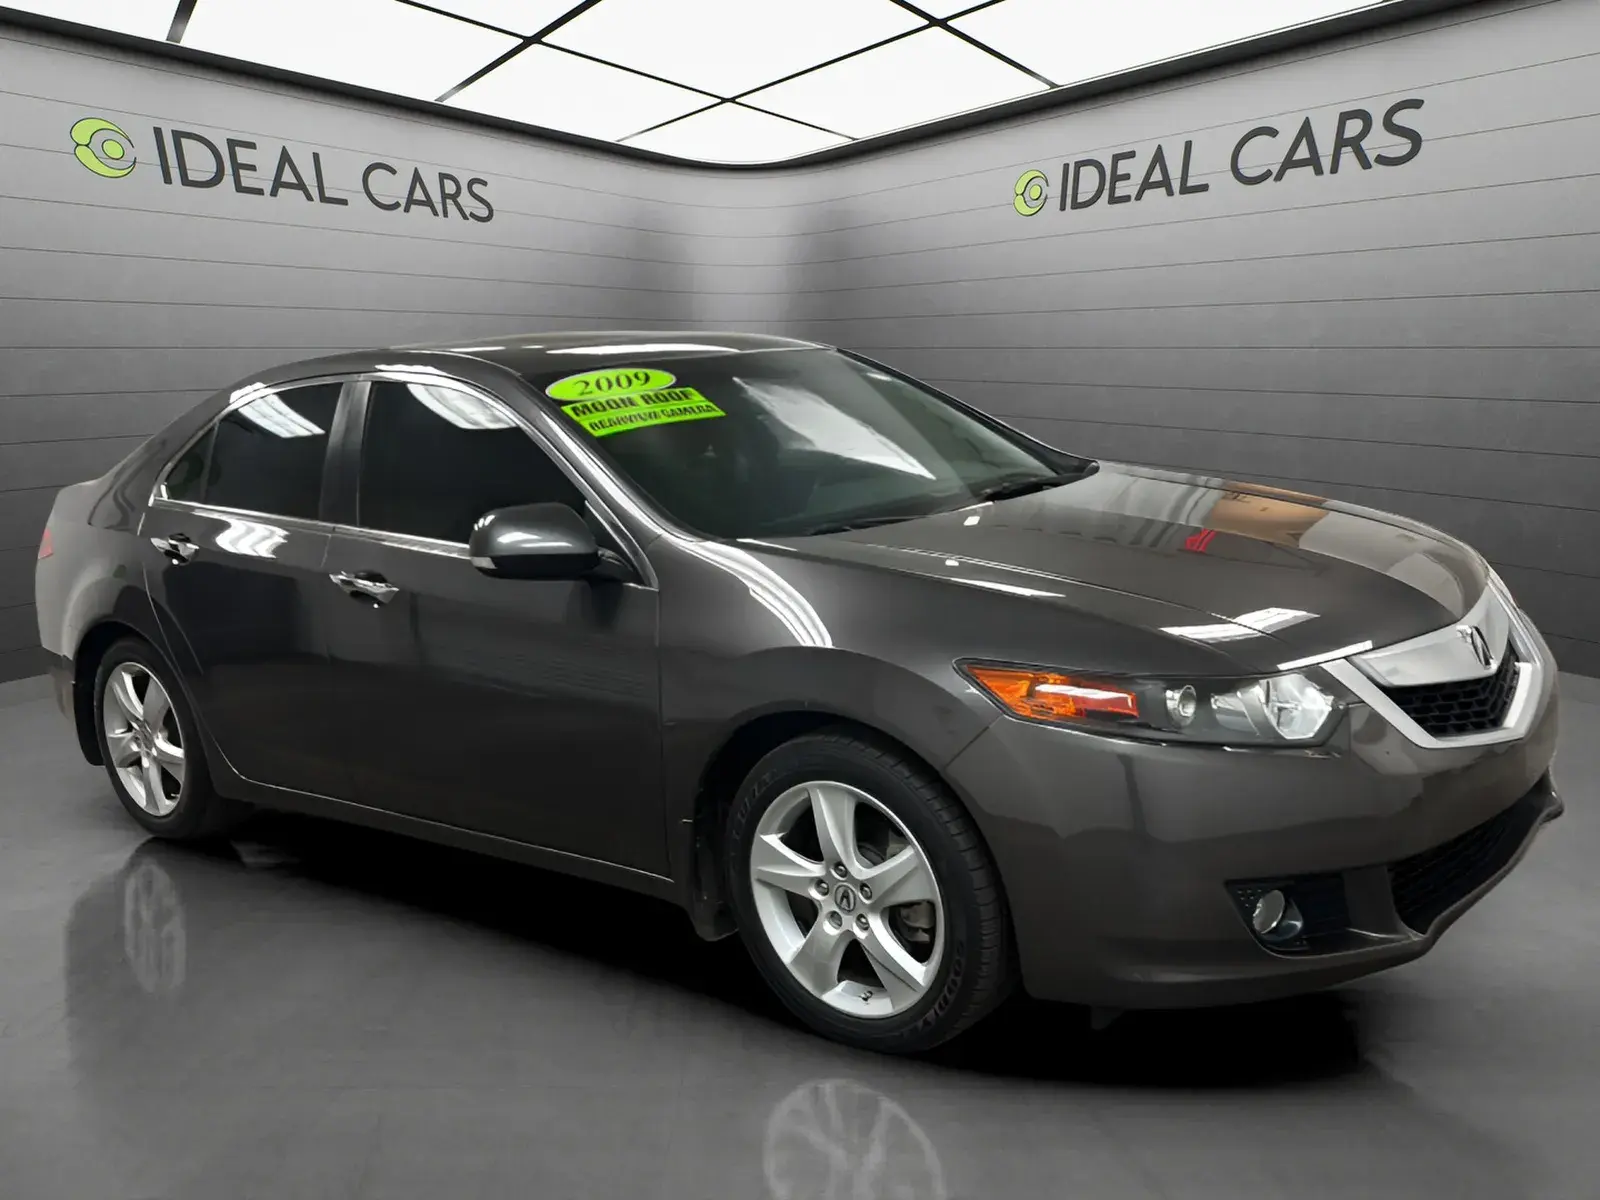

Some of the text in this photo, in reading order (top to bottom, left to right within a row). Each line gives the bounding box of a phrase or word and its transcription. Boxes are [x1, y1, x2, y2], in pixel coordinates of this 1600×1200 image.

[152, 126, 494, 223] IDEAL CARS
[1059, 98, 1424, 212] IDEAL CARS
[571, 389, 692, 417] MOON ROOF
[574, 371, 651, 395] 2009
